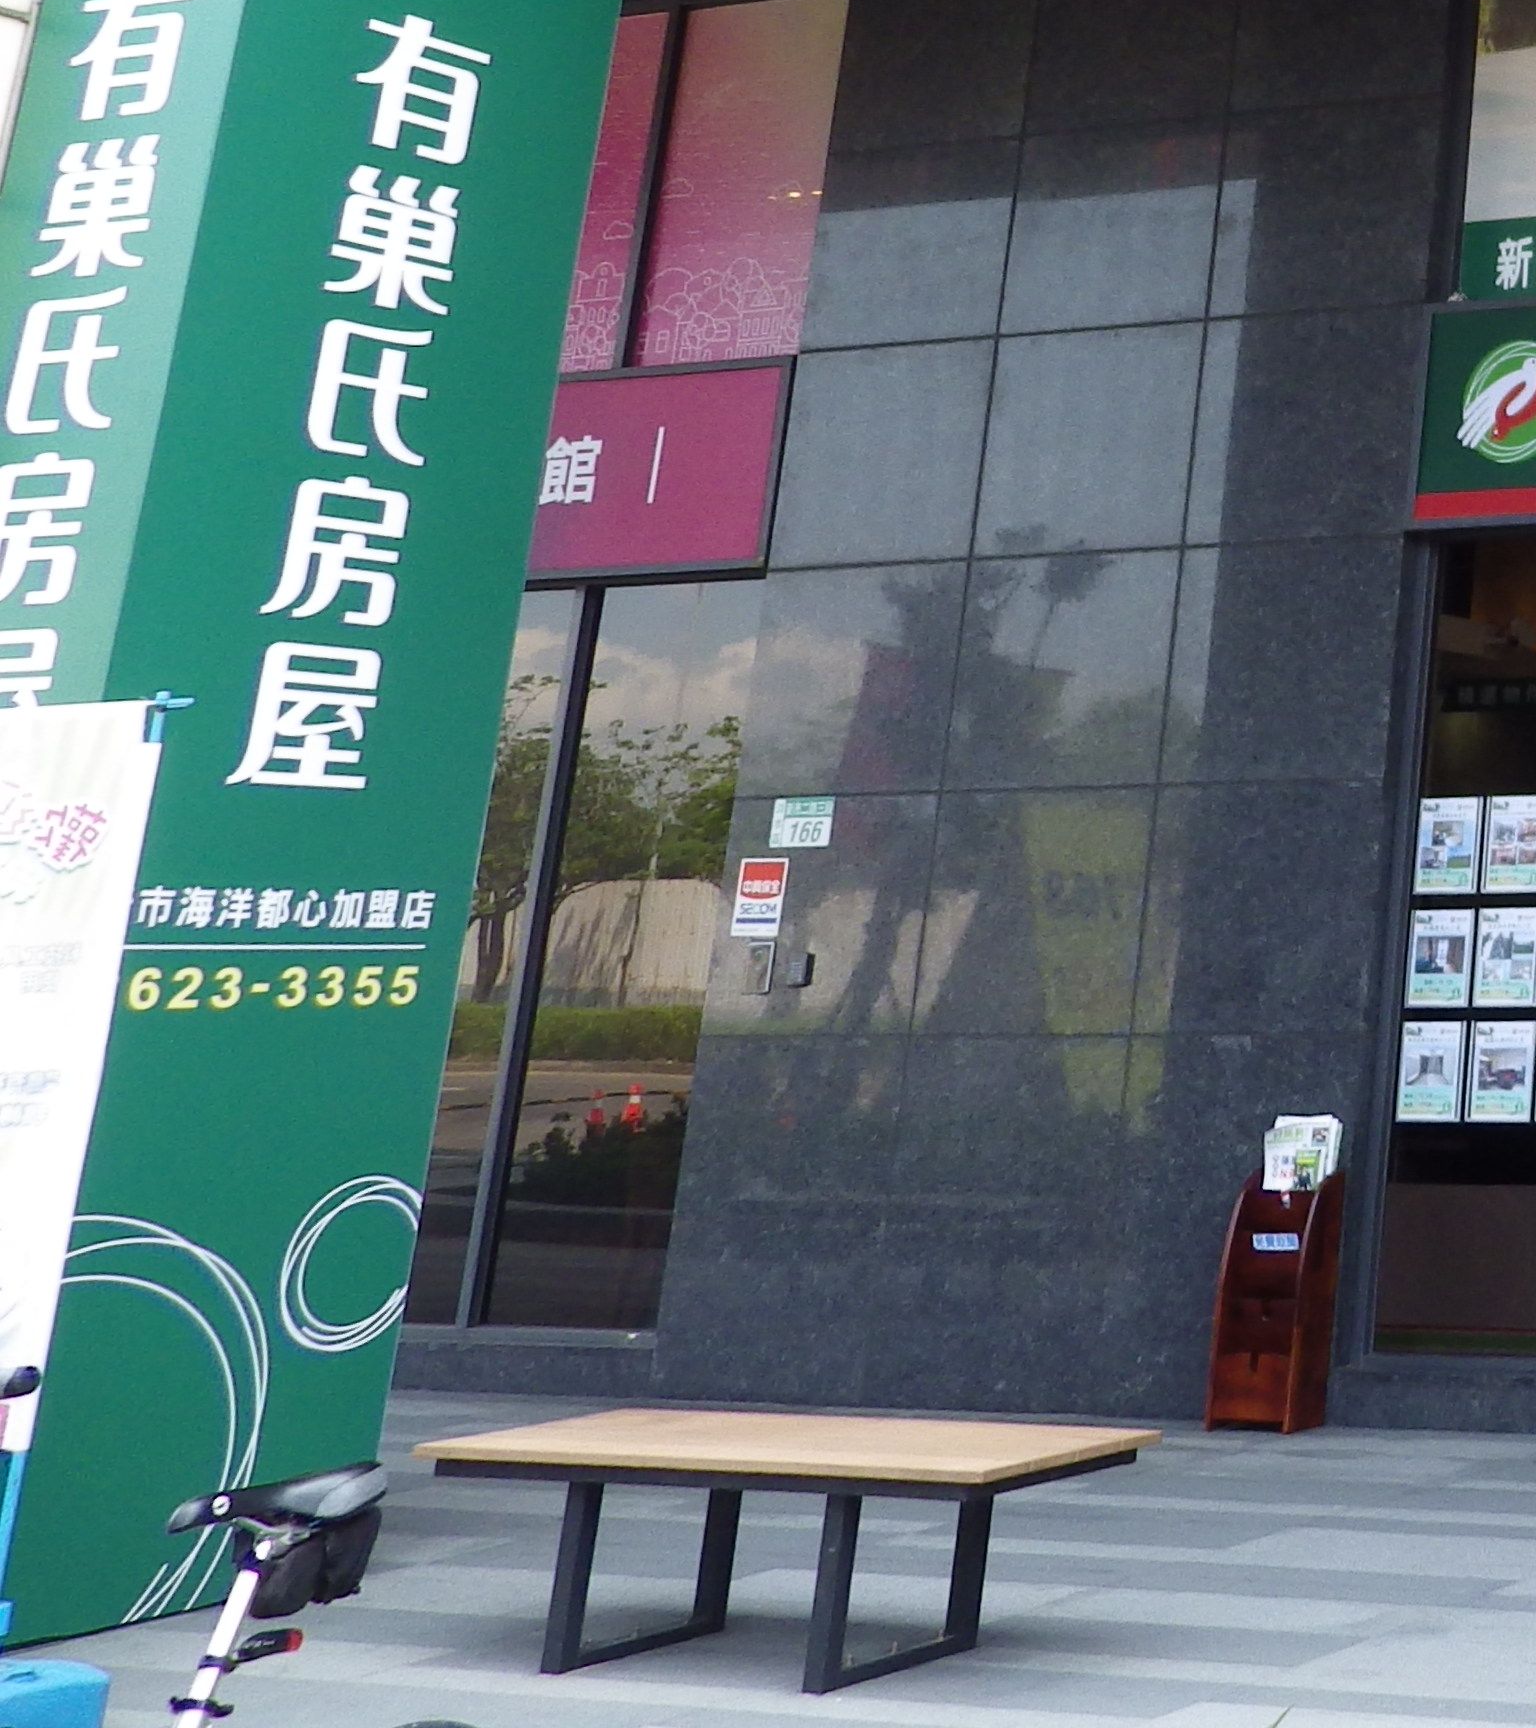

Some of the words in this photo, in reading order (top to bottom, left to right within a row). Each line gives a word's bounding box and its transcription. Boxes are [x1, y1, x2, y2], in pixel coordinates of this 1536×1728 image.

[225, 13, 492, 791] 有巢氏房屋
[790, 821, 823, 843] 166
[130, 885, 436, 930] 市海洋都心加盟店
[127, 967, 420, 1010] 623-3355
